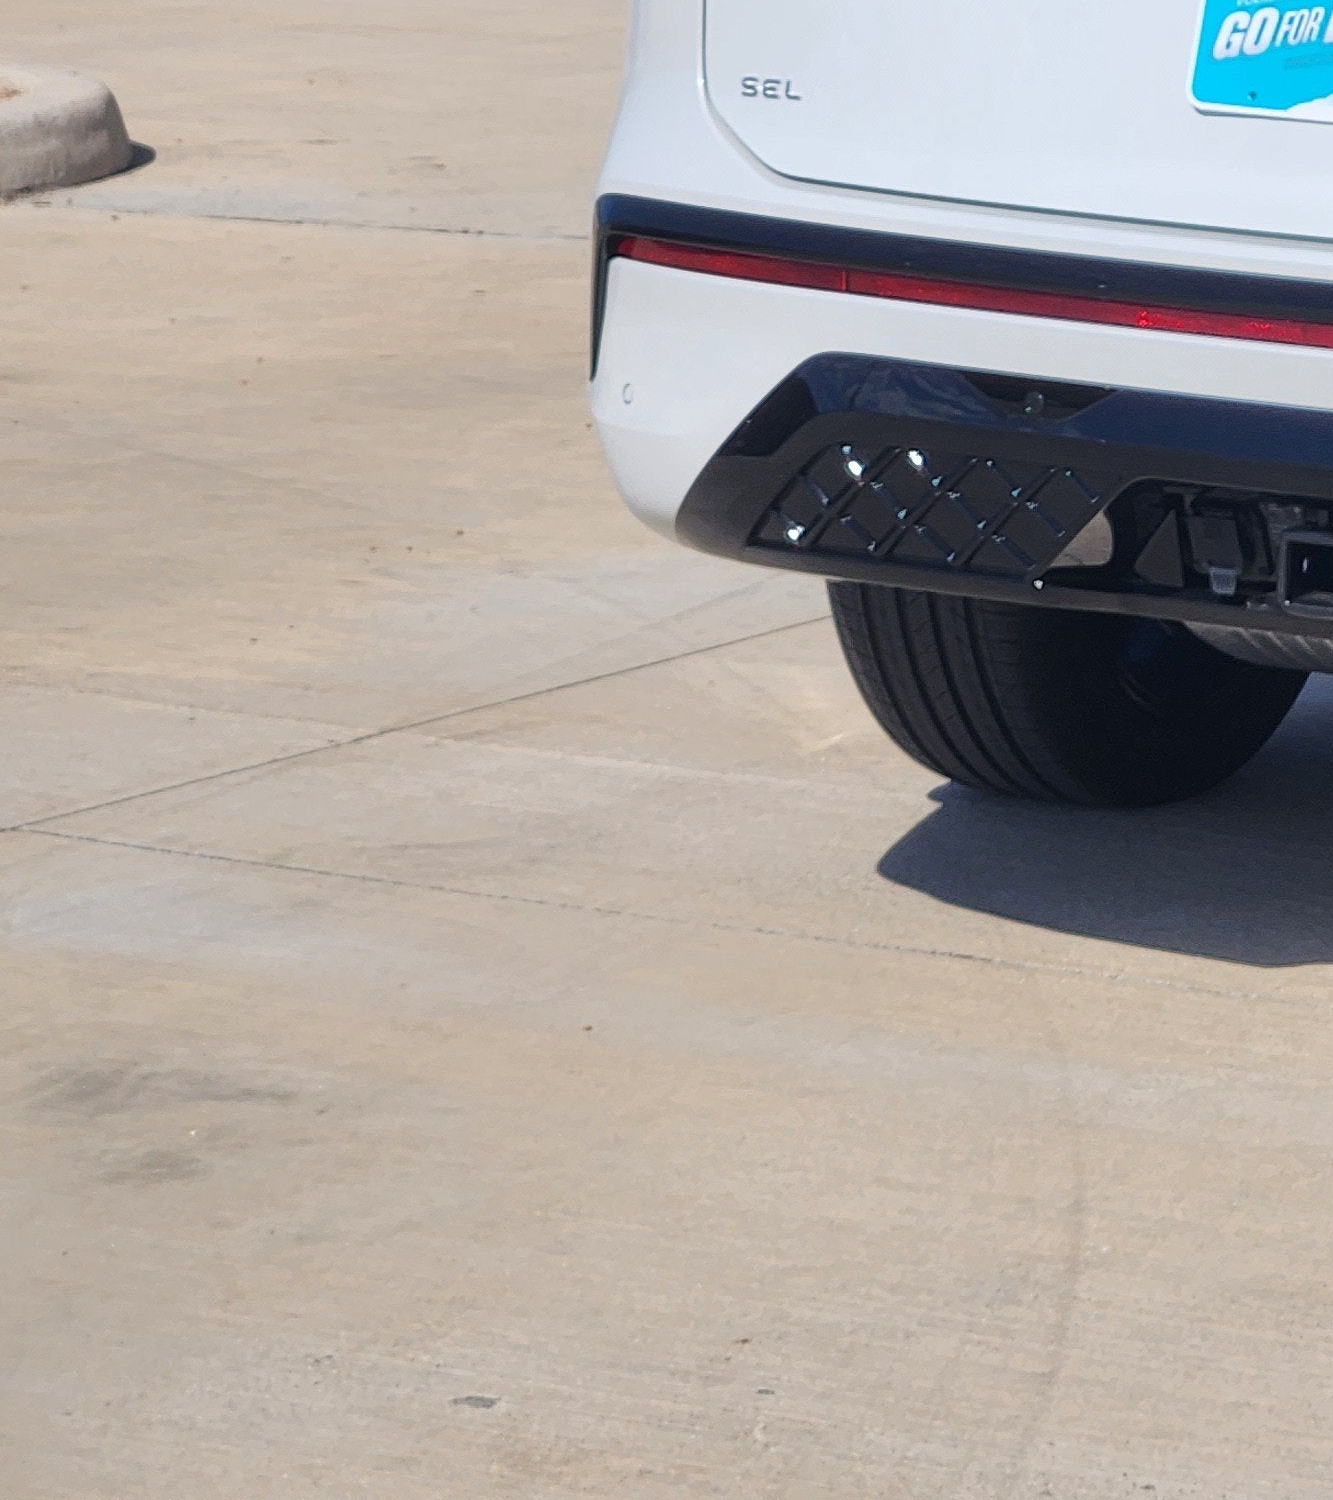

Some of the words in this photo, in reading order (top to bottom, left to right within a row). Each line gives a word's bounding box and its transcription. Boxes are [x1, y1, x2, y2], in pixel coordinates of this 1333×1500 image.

[1212, 6, 1280, 60] GO
[1274, 6, 1326, 48] FOR
[741, 76, 802, 101] SEL
